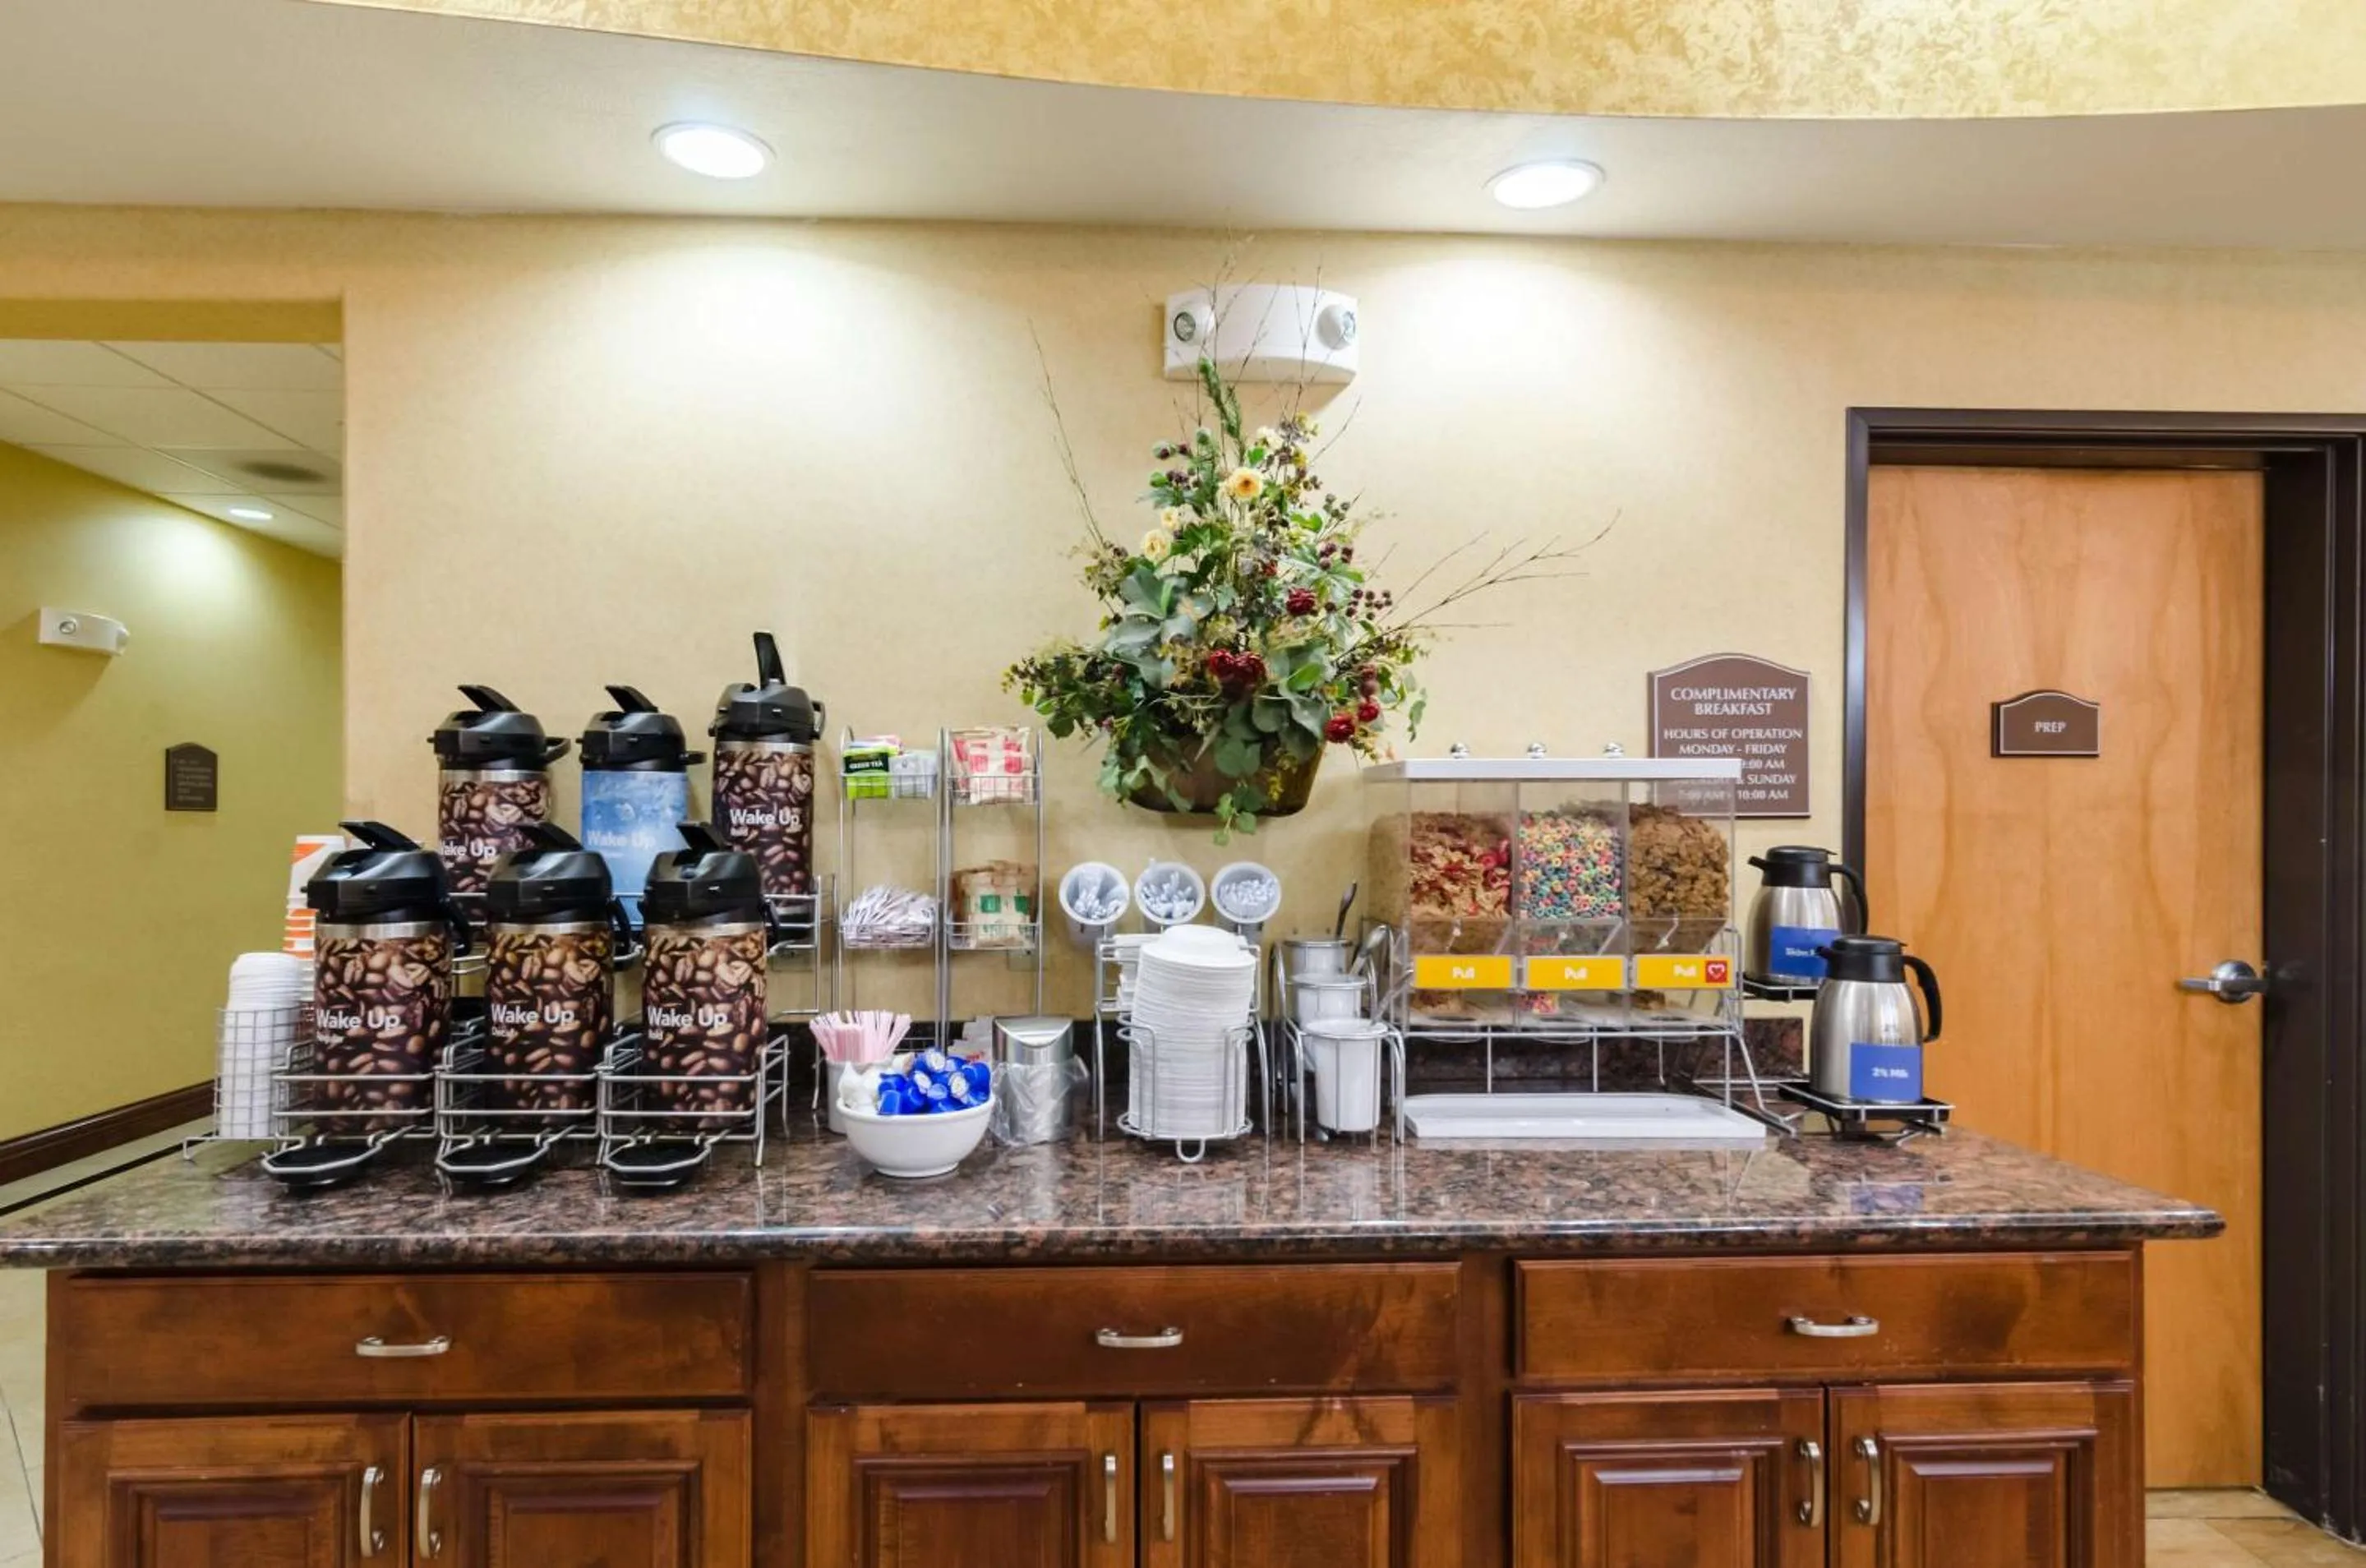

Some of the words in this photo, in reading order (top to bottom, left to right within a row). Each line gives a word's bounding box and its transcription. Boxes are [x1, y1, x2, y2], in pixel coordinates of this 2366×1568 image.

[1671, 687, 1797, 700] COMPLIMENTARY
[1695, 703, 1773, 715] BREAKFAST
[1663, 728, 1709, 740] HOURS
[1711, 728, 1728, 740] OF
[1731, 728, 1803, 740] OPERATION
[2034, 722, 2067, 733] PREP
[1679, 744, 1735, 754] MONDAY
[1745, 744, 1787, 754] FRIDAY
[1764, 759, 1785, 769] AM
[1747, 774, 1797, 784] SUNDAY
[1737, 790, 1766, 800] 10:00
[1768, 790, 1788, 800] AM
[730, 809, 775, 825] Wake
[779, 809, 800, 828] Up
[588, 830, 627, 846] Wake
[631, 831, 656, 850] Up
[470, 838, 496, 860] Up
[1452, 966, 1475, 979] Pull
[1565, 966, 1587, 980] Pull
[316, 1009, 362, 1028] Wake
[367, 1010, 400, 1031] Up
[491, 1003, 538, 1024] Wake
[544, 1003, 574, 1028] Up
[648, 1005, 693, 1026] Wake
[699, 1005, 727, 1030] Up
